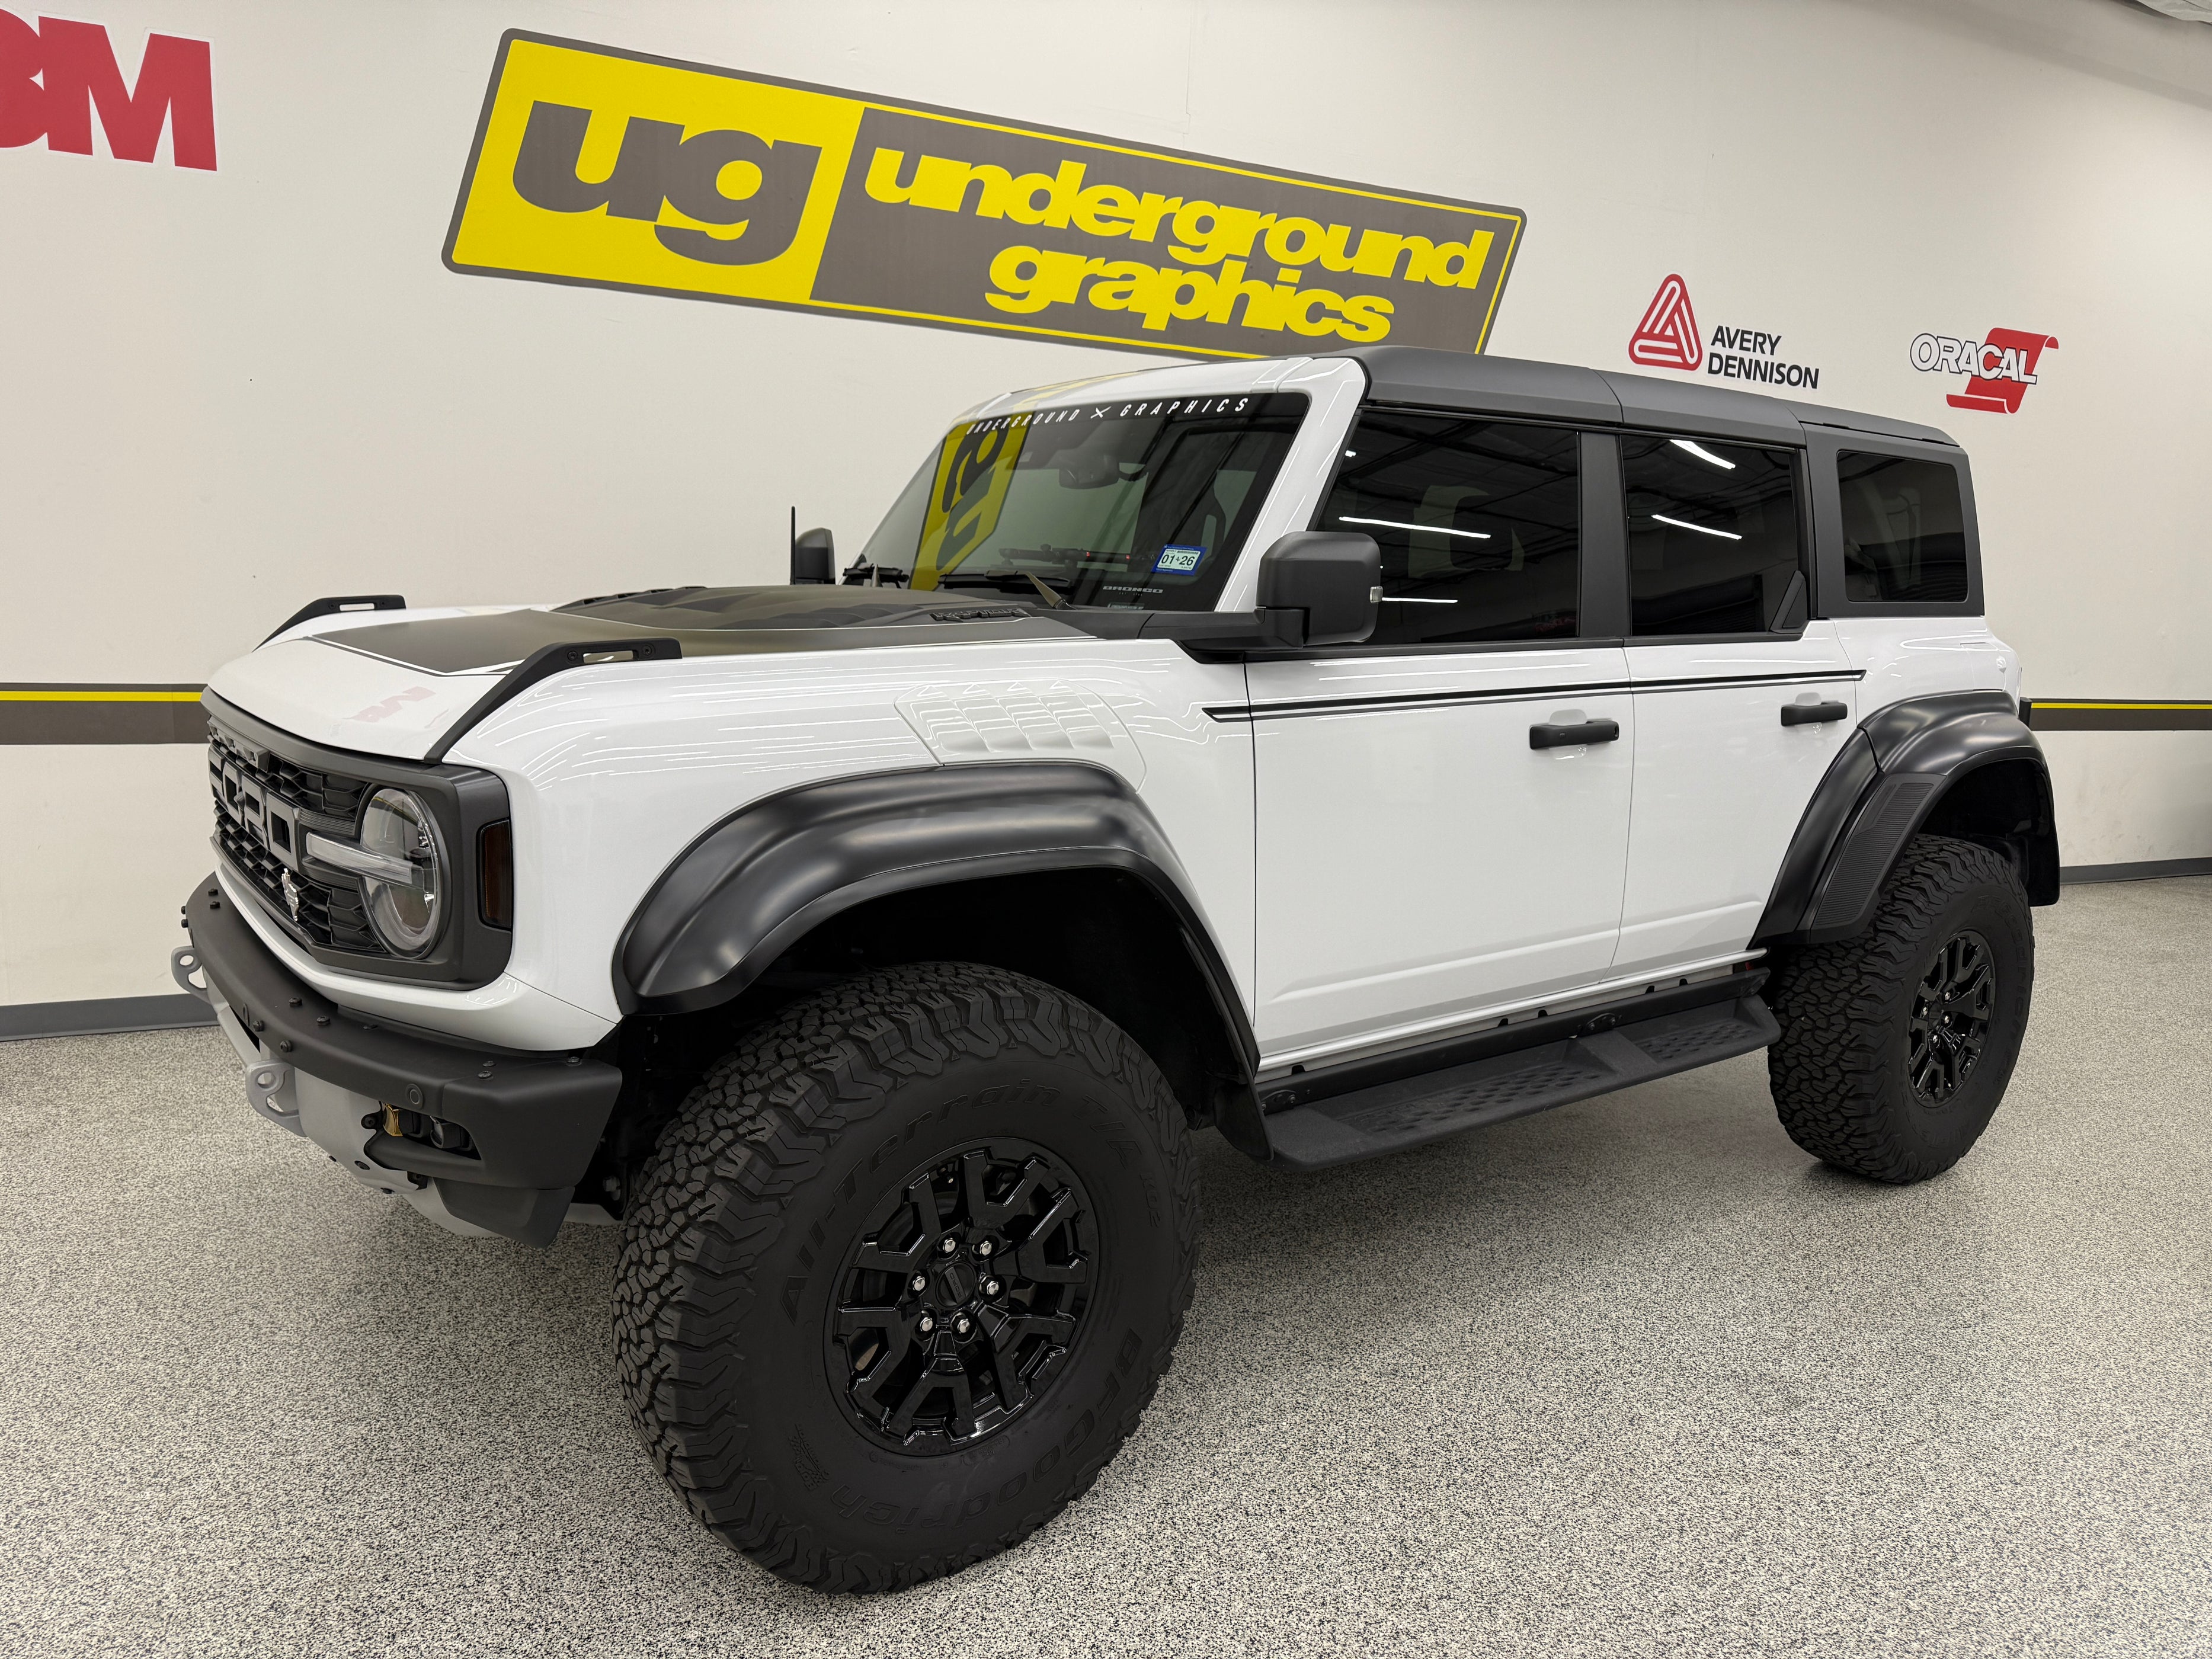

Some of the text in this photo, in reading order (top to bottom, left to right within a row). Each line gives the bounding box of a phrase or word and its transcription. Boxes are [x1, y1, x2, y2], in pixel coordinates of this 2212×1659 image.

[513, 100, 822, 265] ug
[865, 147, 1494, 289] underground
[985, 245, 1394, 342] graphics
[1711, 325, 1782, 356] AVERY
[1707, 352, 1819, 389] DENNISON
[1910, 332, 2038, 385] ORACAL
[966, 408, 1080, 435] UNDERGROUND
[1119, 398, 1249, 417] GRAPHICS
[1103, 585, 1163, 594] BRONCO
[207, 744, 300, 873] FORD
[779, 1077, 1062, 1327] All-Terrain
[829, 1327, 1144, 1536] BFGoodrich
